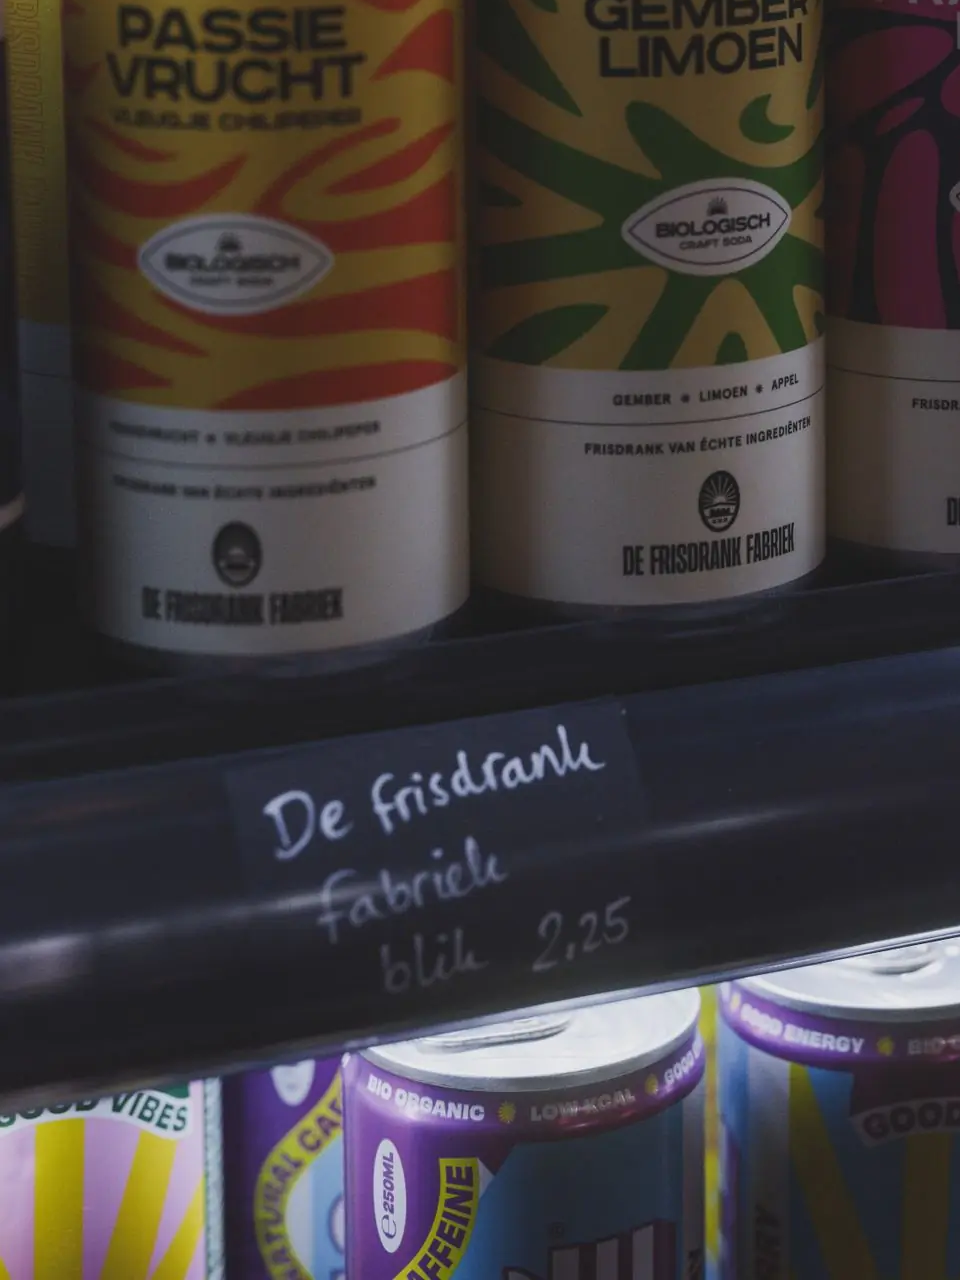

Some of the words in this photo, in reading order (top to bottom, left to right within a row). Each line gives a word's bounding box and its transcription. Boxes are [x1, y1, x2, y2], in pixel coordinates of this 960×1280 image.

[118, 5, 347, 52] PASSIE
[600, 23, 803, 78] LIMOEN
[105, 53, 365, 105] VRUCHT
[655, 212, 771, 239] BIOLOGISCH
[612, 392, 672, 407] GEMBER
[699, 385, 749, 403] LIMOEN
[771, 373, 799, 392] APPEL
[584, 441, 664, 457] FRISDRANK
[668, 440, 696, 454] VAN
[700, 434, 743, 452] ÉCHTE
[745, 415, 812, 446] INGREDIËNTEN
[622, 544, 645, 577] DE
[650, 535, 742, 577] FRISDRANK
[746, 522, 795, 566] FABRIEK
[263, 789, 353, 861] De
[784, 1023, 865, 1054] ENERGY
[111, 1091, 188, 1132] VIBES
[366, 1073, 393, 1101] BIO
[395, 1088, 486, 1122] ORGANIC
